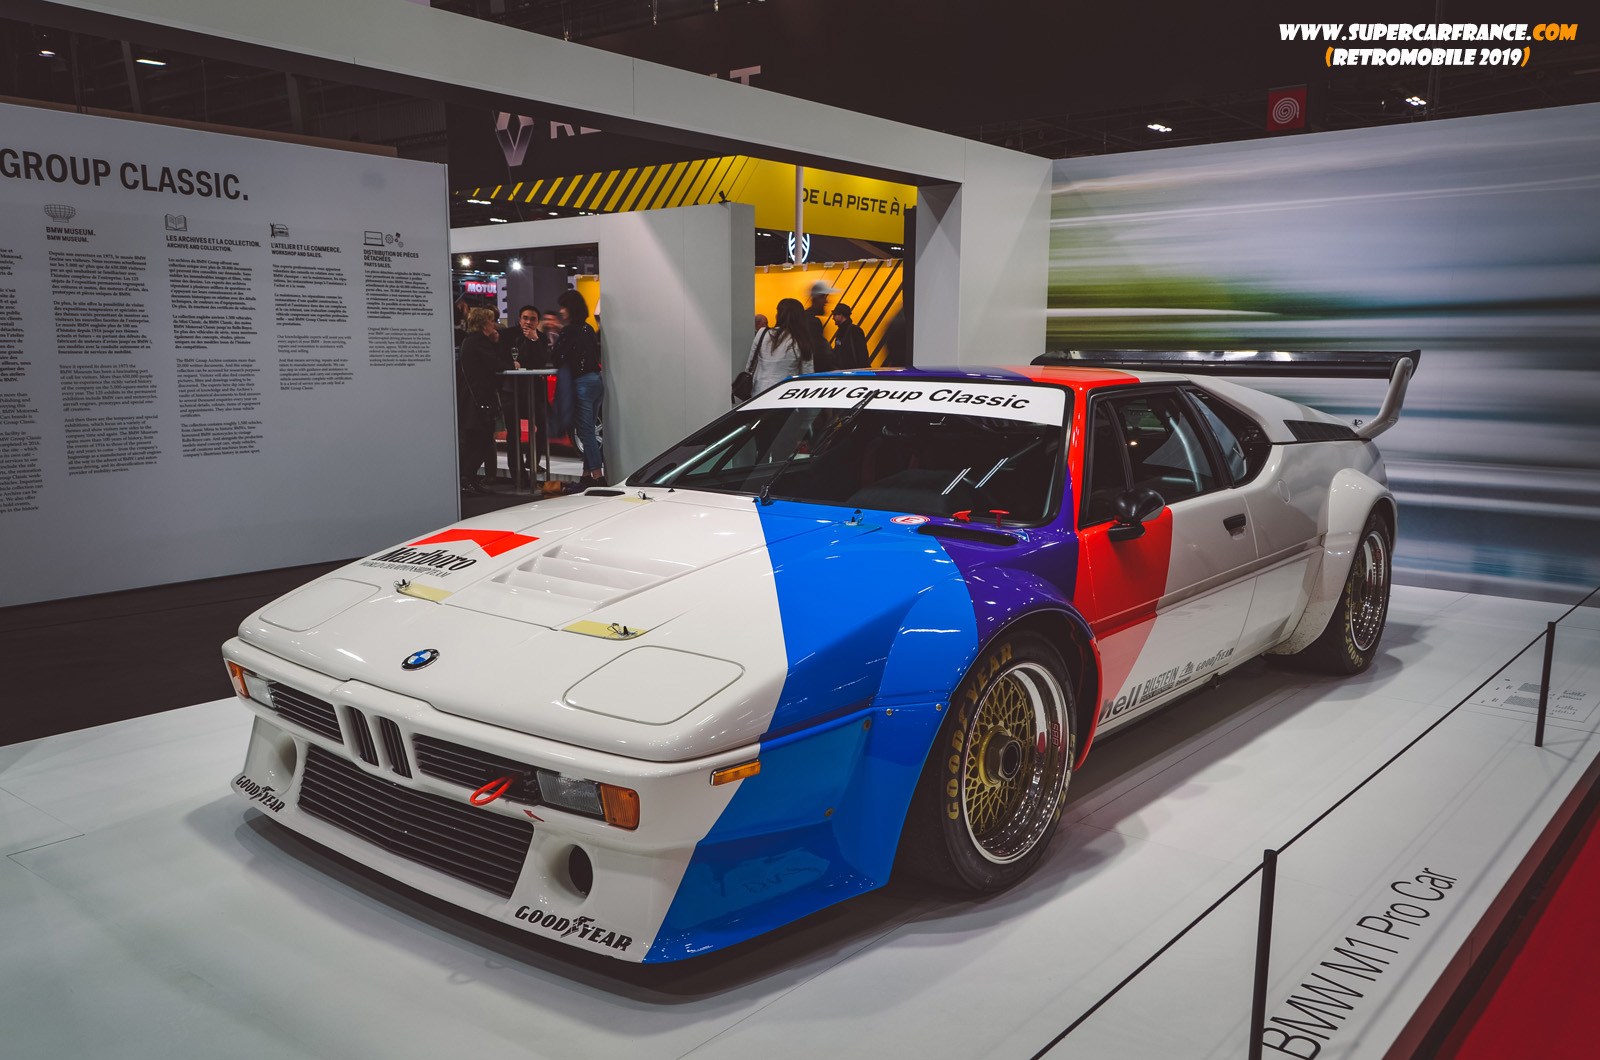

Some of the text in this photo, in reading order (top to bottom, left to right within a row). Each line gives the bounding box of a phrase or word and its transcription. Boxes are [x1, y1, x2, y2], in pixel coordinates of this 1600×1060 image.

[0, 148, 248, 200] GROUP CLASSIC.
[823, 191, 843, 208] LA
[846, 194, 888, 214] PISTE
[890, 197, 900, 216] À
[64, 228, 96, 236] MUSEUM.
[468, 283, 497, 294] MOTUL
[778, 386, 1030, 409] BMW Group Classic
[372, 547, 477, 571] Marlboro
[1098, 683, 1142, 721] hell
[1143, 666, 1180, 695] BILSTEIN
[1196, 648, 1234, 672] GOODYEAR
[946, 642, 1012, 820] GOODYEAR
[235, 775, 286, 812] GOODYEAR
[514, 905, 632, 952] GOODYEAR
[1262, 867, 1457, 1060] BMW M1 Pro Car
